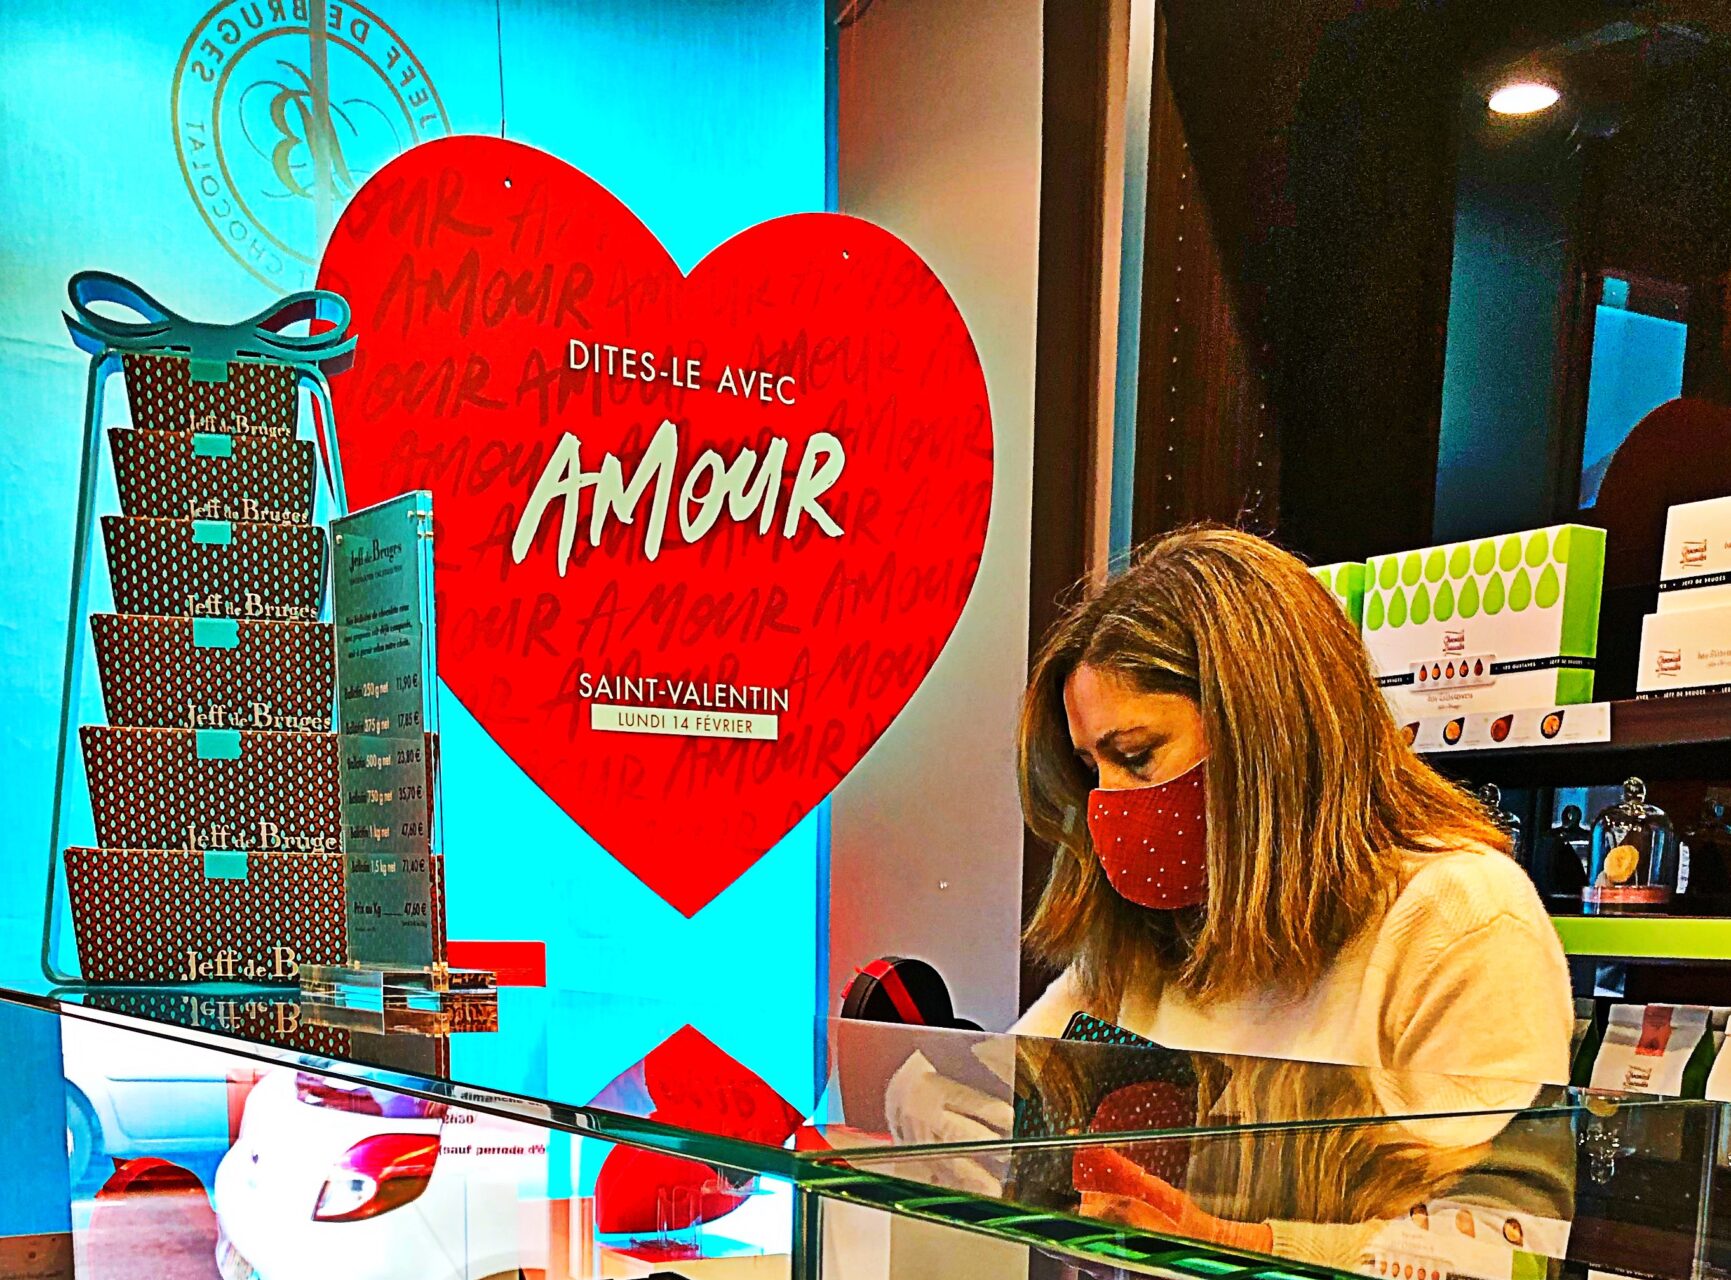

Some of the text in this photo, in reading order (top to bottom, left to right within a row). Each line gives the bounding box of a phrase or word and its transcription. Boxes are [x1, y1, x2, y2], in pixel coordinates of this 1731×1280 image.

[567, 338, 798, 407] DITES-LE AVEC
[236, 414, 292, 439] Bruges
[511, 418, 847, 579] AMOUR
[241, 498, 308, 526] Bruges
[184, 594, 223, 619] Jeff
[226, 602, 242, 616] de
[244, 593, 318, 620] Bruges
[412, 673, 418, 688] €
[578, 672, 790, 713] SAINT-VALENTIN
[184, 702, 331, 733] Jeff de Bruges
[414, 711, 419, 725] €
[617, 711, 754, 737] LUNDI 14 FÉVRIER
[415, 748, 421, 763] €
[416, 785, 422, 799] €
[184, 824, 231, 852] Jeff
[234, 832, 254, 849] de
[418, 822, 423, 836] €
[419, 859, 425, 873] €
[421, 902, 427, 916] €
[182, 949, 239, 980] Jeff
[243, 959, 267, 978] de
